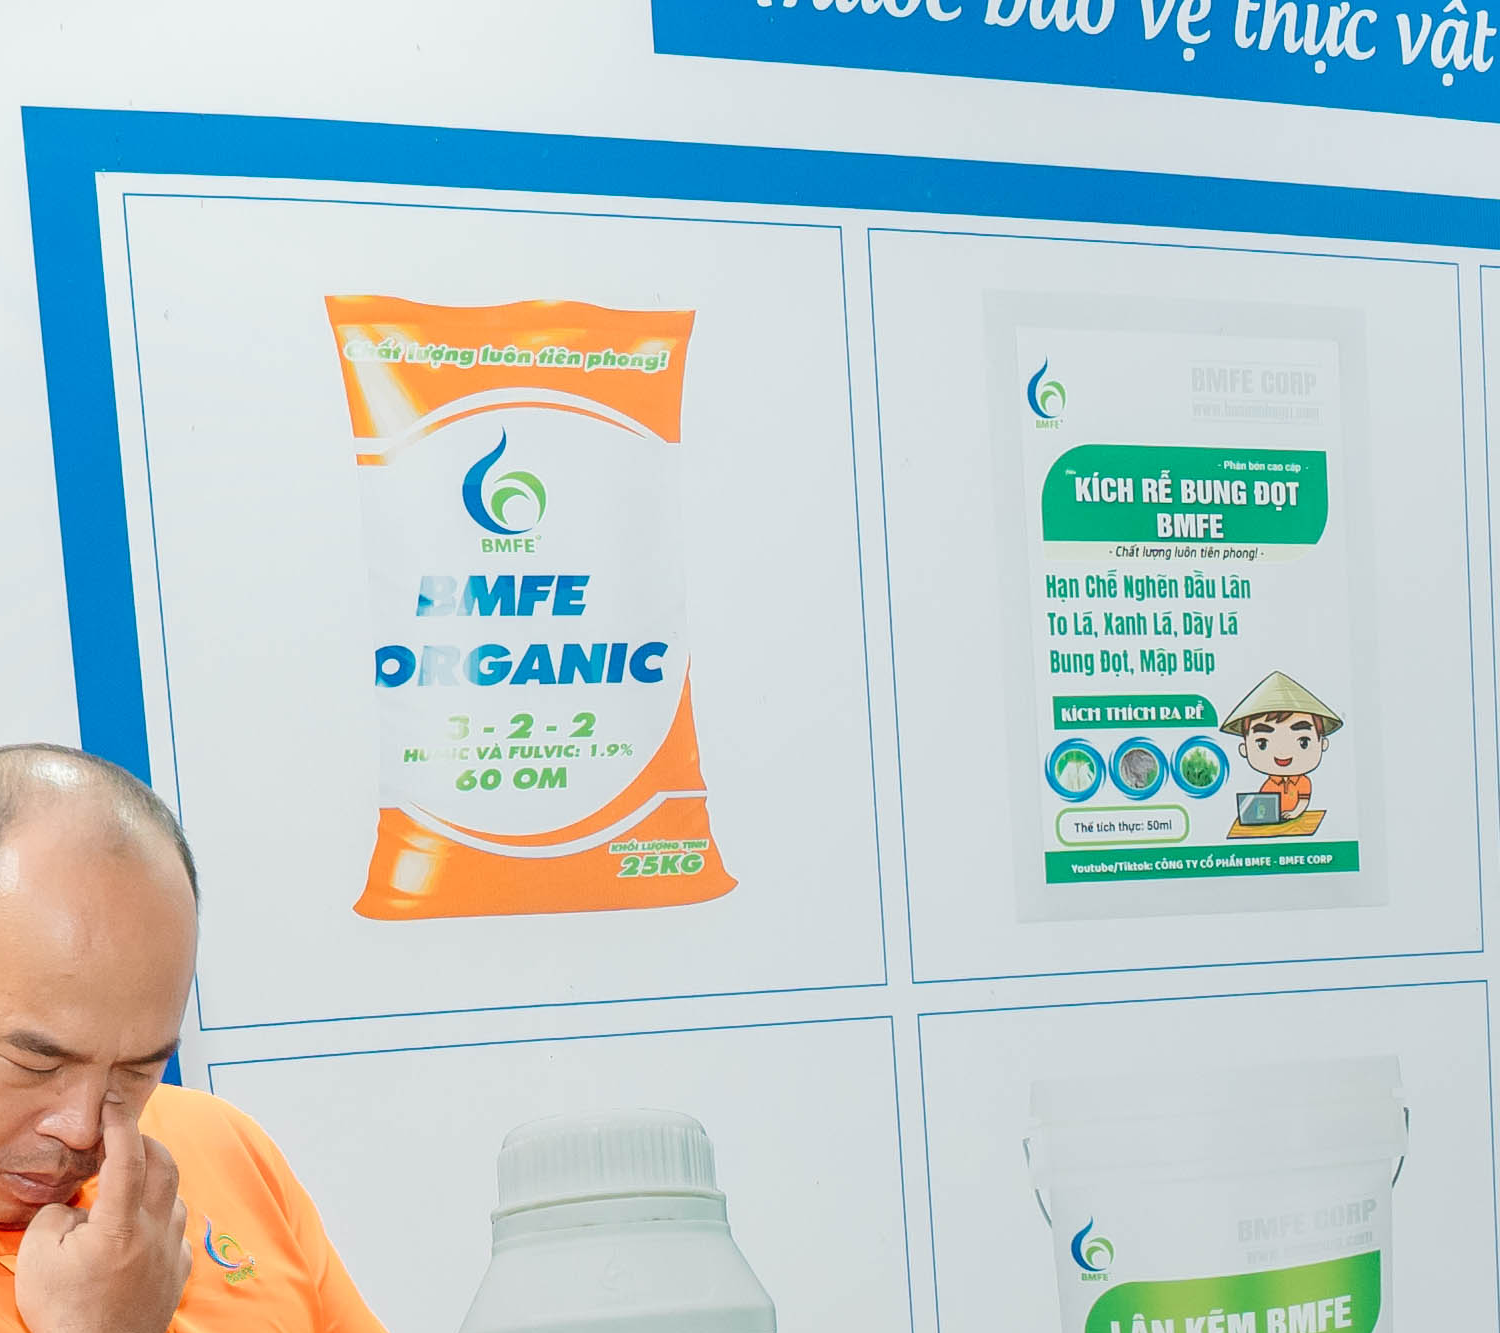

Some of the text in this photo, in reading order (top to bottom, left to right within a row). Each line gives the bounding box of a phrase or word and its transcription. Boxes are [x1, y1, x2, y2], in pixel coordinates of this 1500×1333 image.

[1234, 0, 1377, 74] thực
[1396, 0, 1497, 87] vật
[482, 345, 531, 365] luôn
[538, 348, 580, 367] tiên
[587, 351, 667, 372] phong!
[1075, 470, 1299, 511] KÍCH RỄ BUNG ĐỌT
[1157, 513, 1224, 539] BMFE
[482, 537, 535, 552] BMFE
[415, 575, 591, 617] BMFE
[1046, 574, 1079, 602] Hạn
[1184, 569, 1216, 599] Đầu
[1221, 575, 1251, 599] Lân
[1048, 612, 1067, 636] To
[1104, 612, 1147, 635] Xanh
[1219, 612, 1238, 635] Lá
[374, 641, 669, 688] ORGANIC
[1050, 648, 1215, 677] Bung Đọt, Mập Búp
[506, 713, 533, 739] 2
[569, 712, 596, 737] 2
[1061, 705, 1100, 722] KÍCH
[1106, 703, 1155, 721] THÍCH
[1160, 706, 1181, 720] RA
[404, 742, 633, 763] HUIC VÀ FULVIC: 1.9%
[456, 767, 567, 791] 60 OM
[618, 854, 704, 876] 25KG
